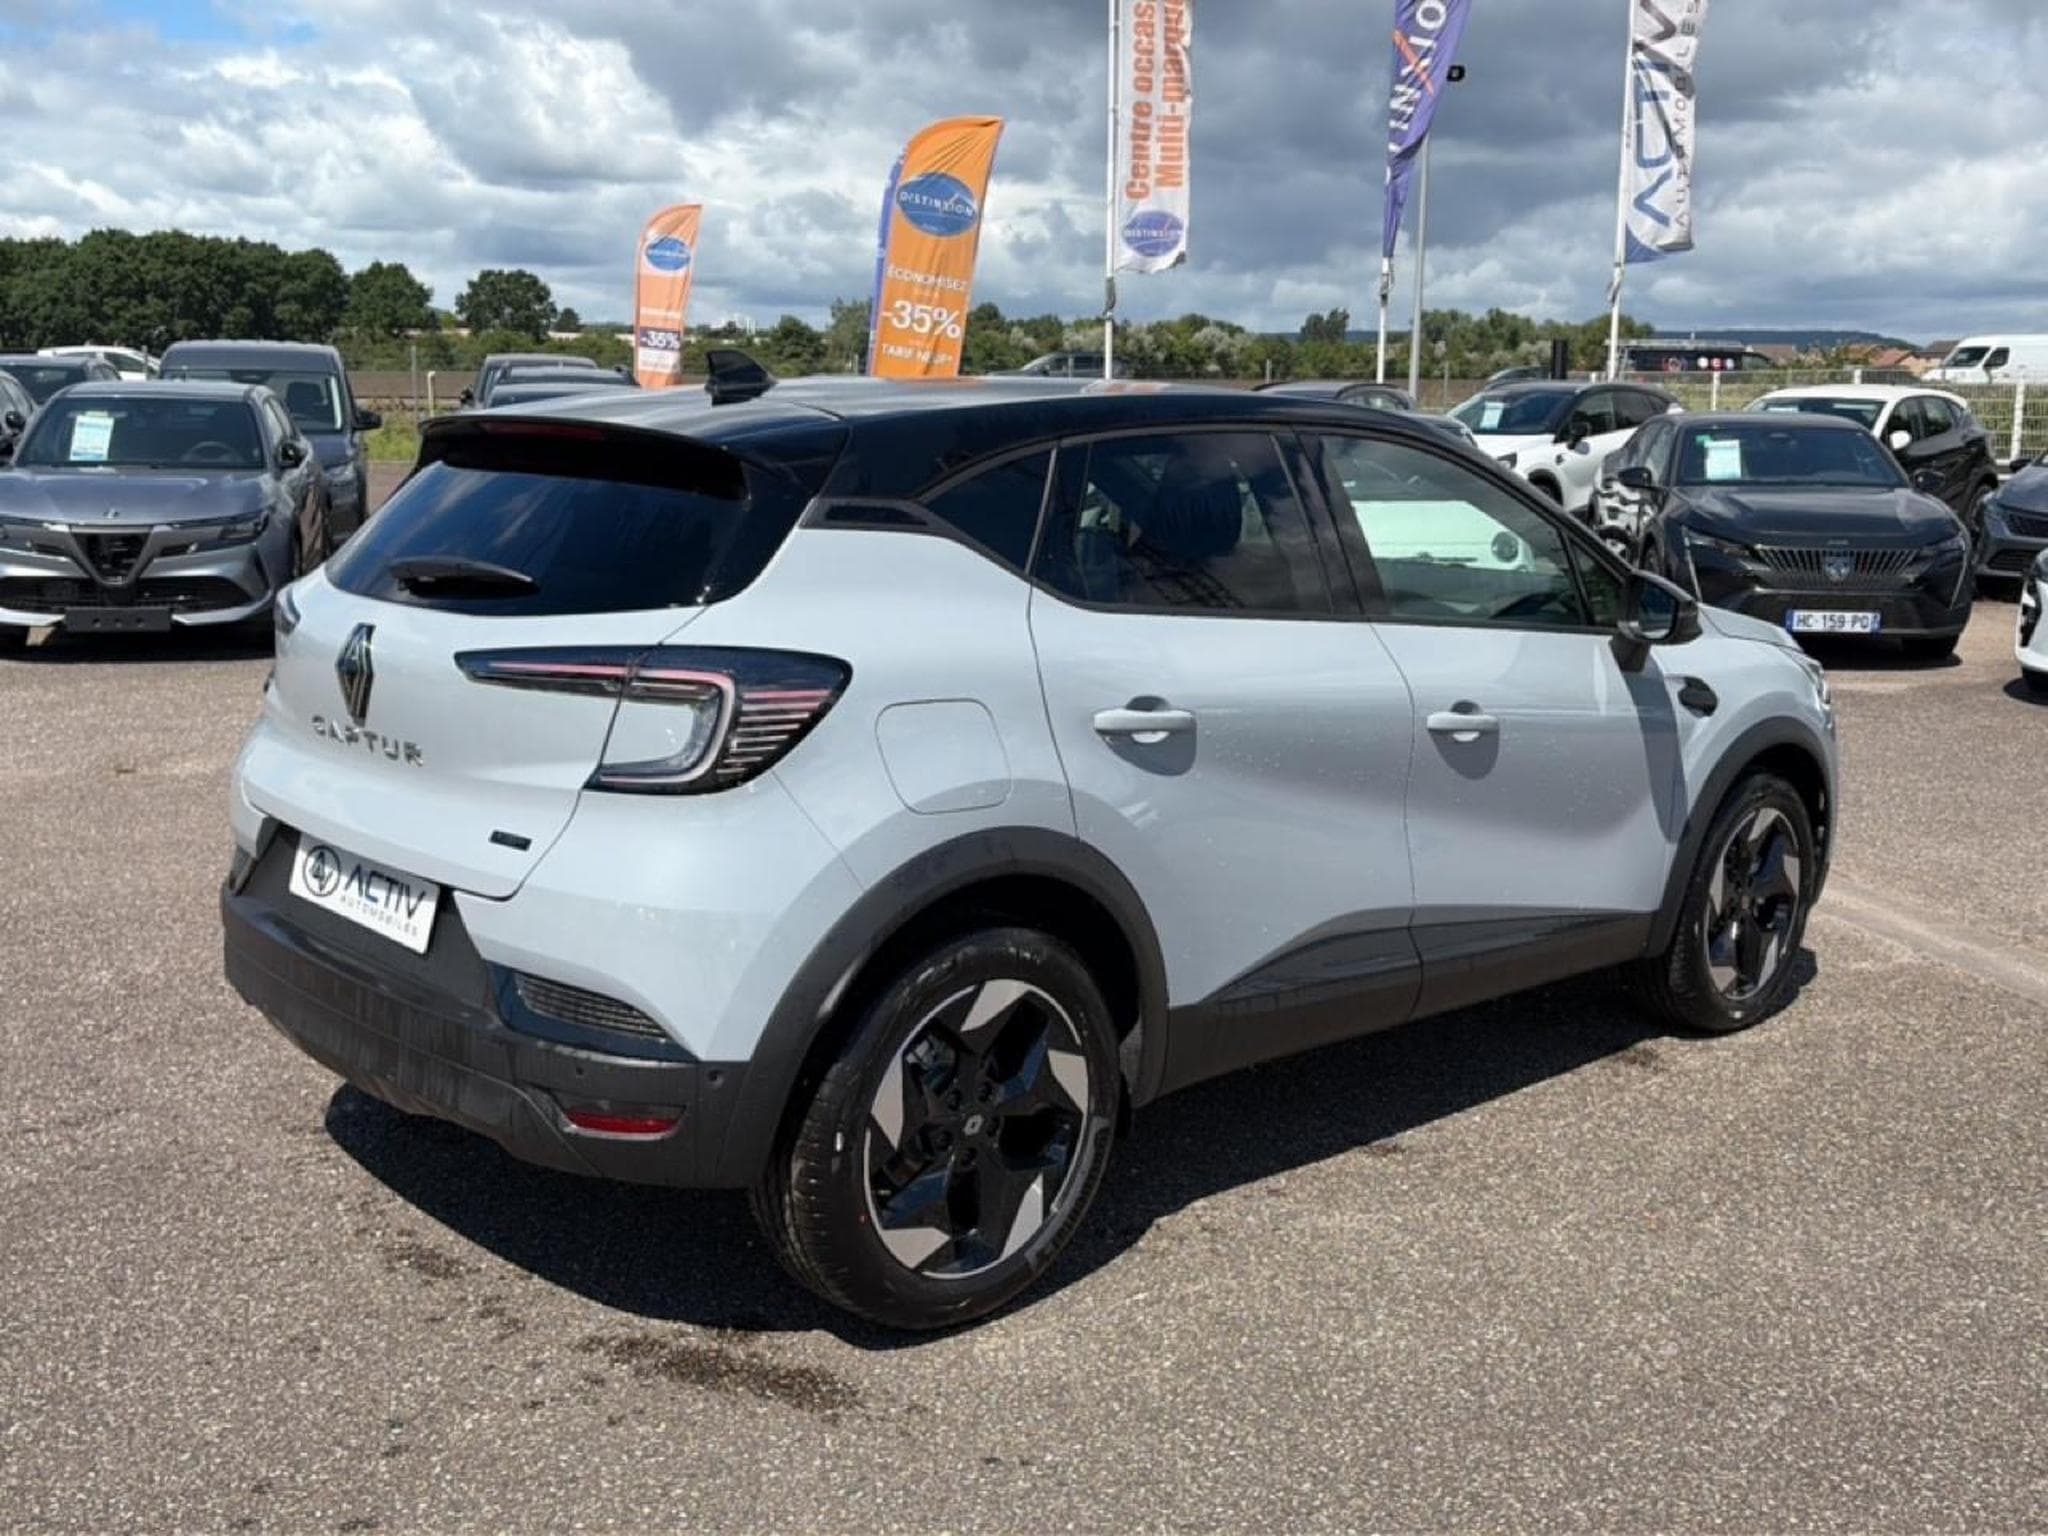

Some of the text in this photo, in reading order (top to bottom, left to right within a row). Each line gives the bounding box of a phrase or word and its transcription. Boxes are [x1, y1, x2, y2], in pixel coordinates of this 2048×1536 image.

[1126, 100, 1153, 200] Centre
[881, 300, 960, 338] -35%
[311, 715, 424, 767] CAPTUR
[345, 863, 427, 919] ACTIV
